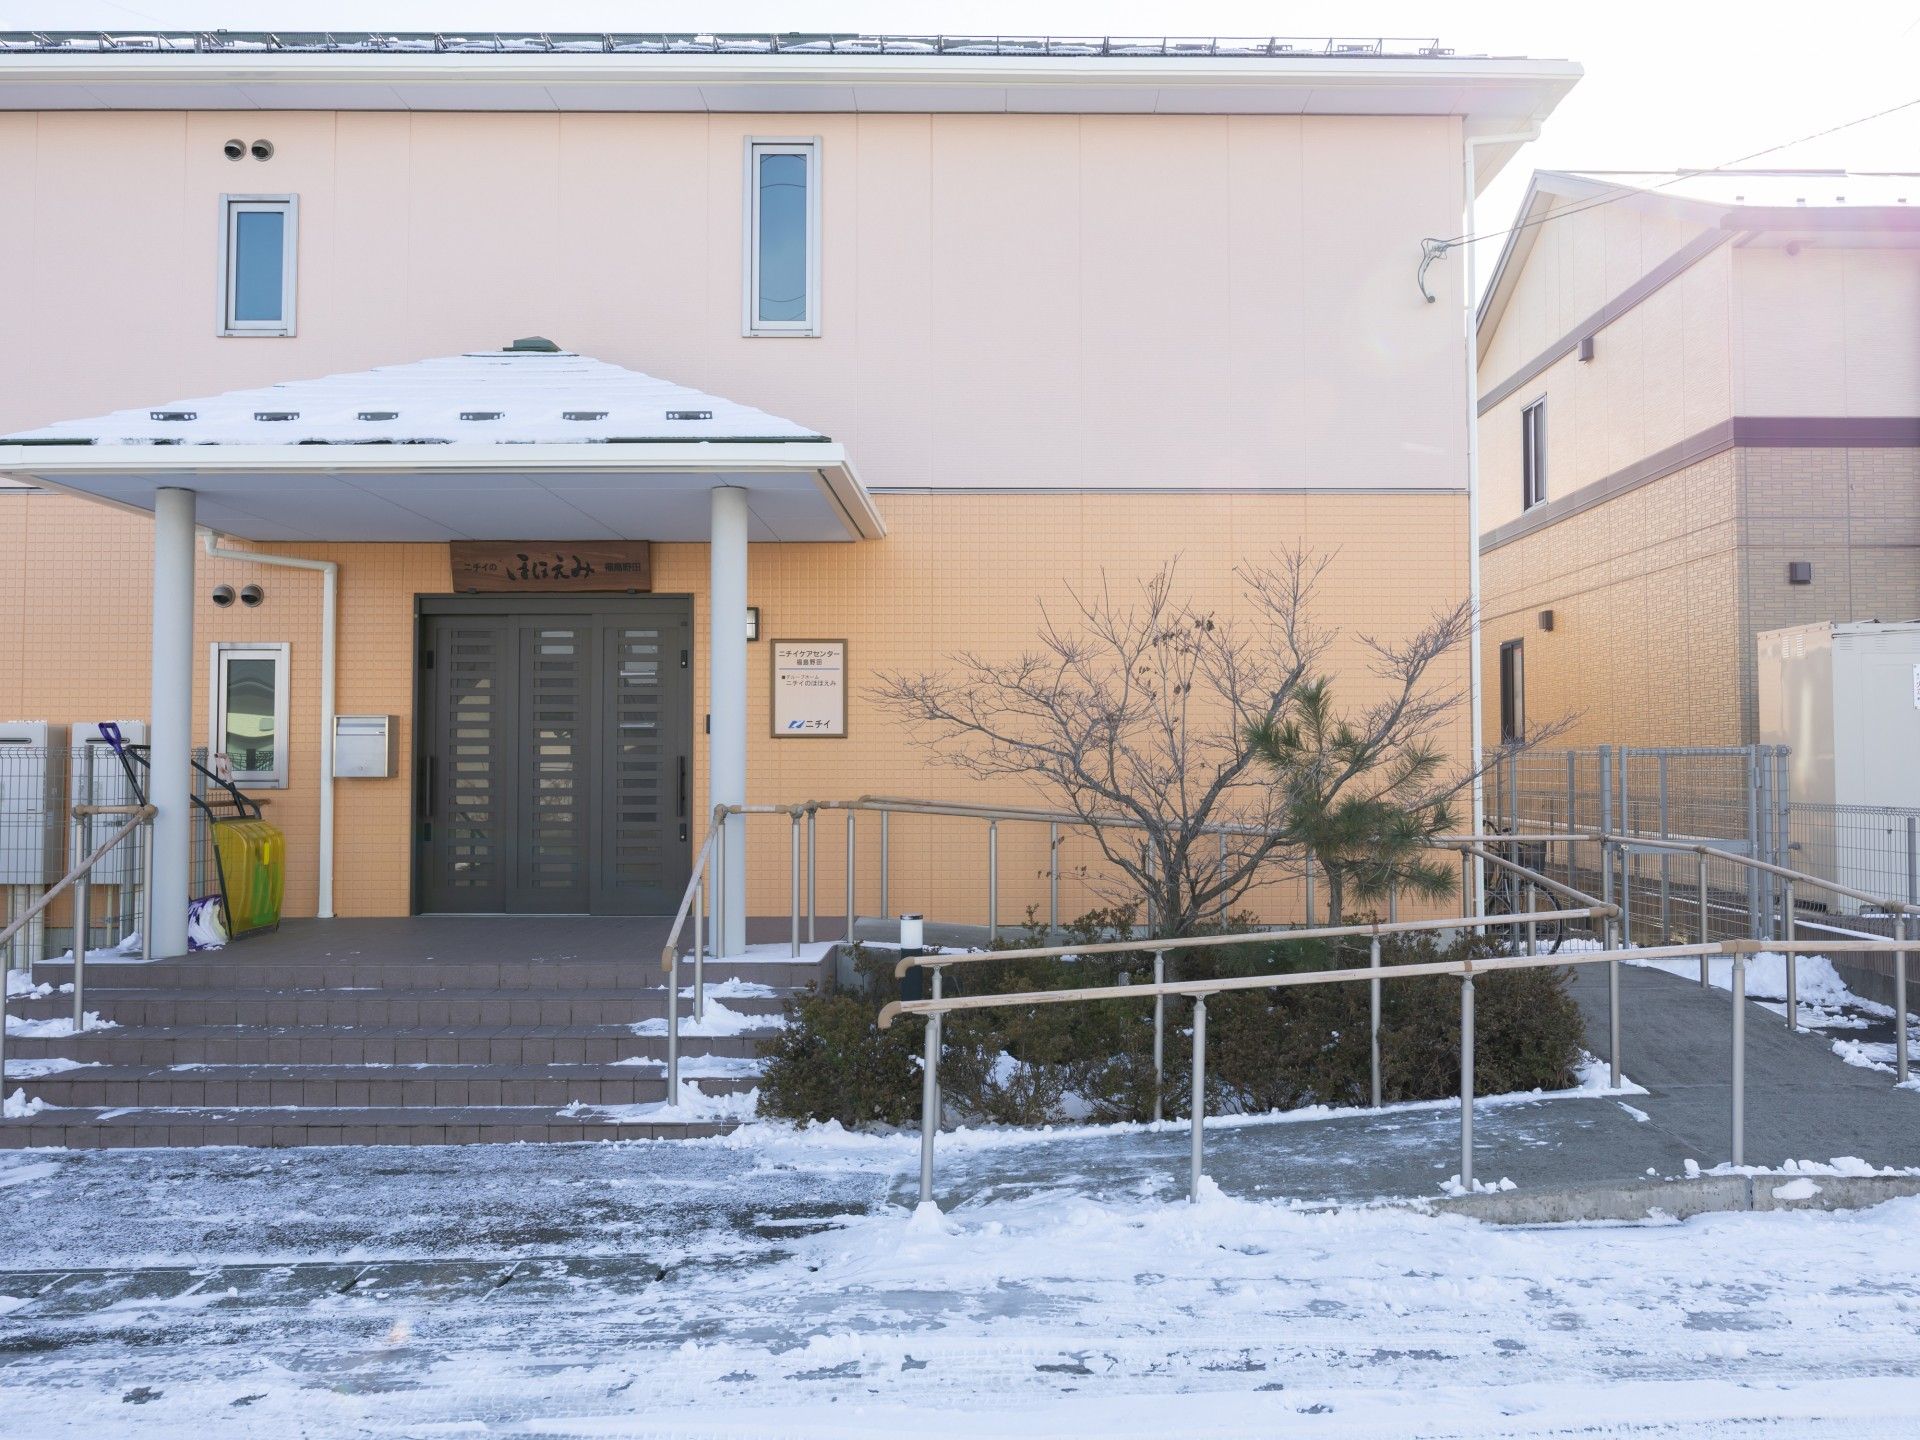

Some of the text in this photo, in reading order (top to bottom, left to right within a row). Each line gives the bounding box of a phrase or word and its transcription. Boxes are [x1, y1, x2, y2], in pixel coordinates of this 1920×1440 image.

[463, 562, 497, 572] ニチイの
[506, 553, 595, 581] ほほえみ
[778, 650, 840, 658] ニチイケアセンター
[805, 719, 831, 729] ニチイ
